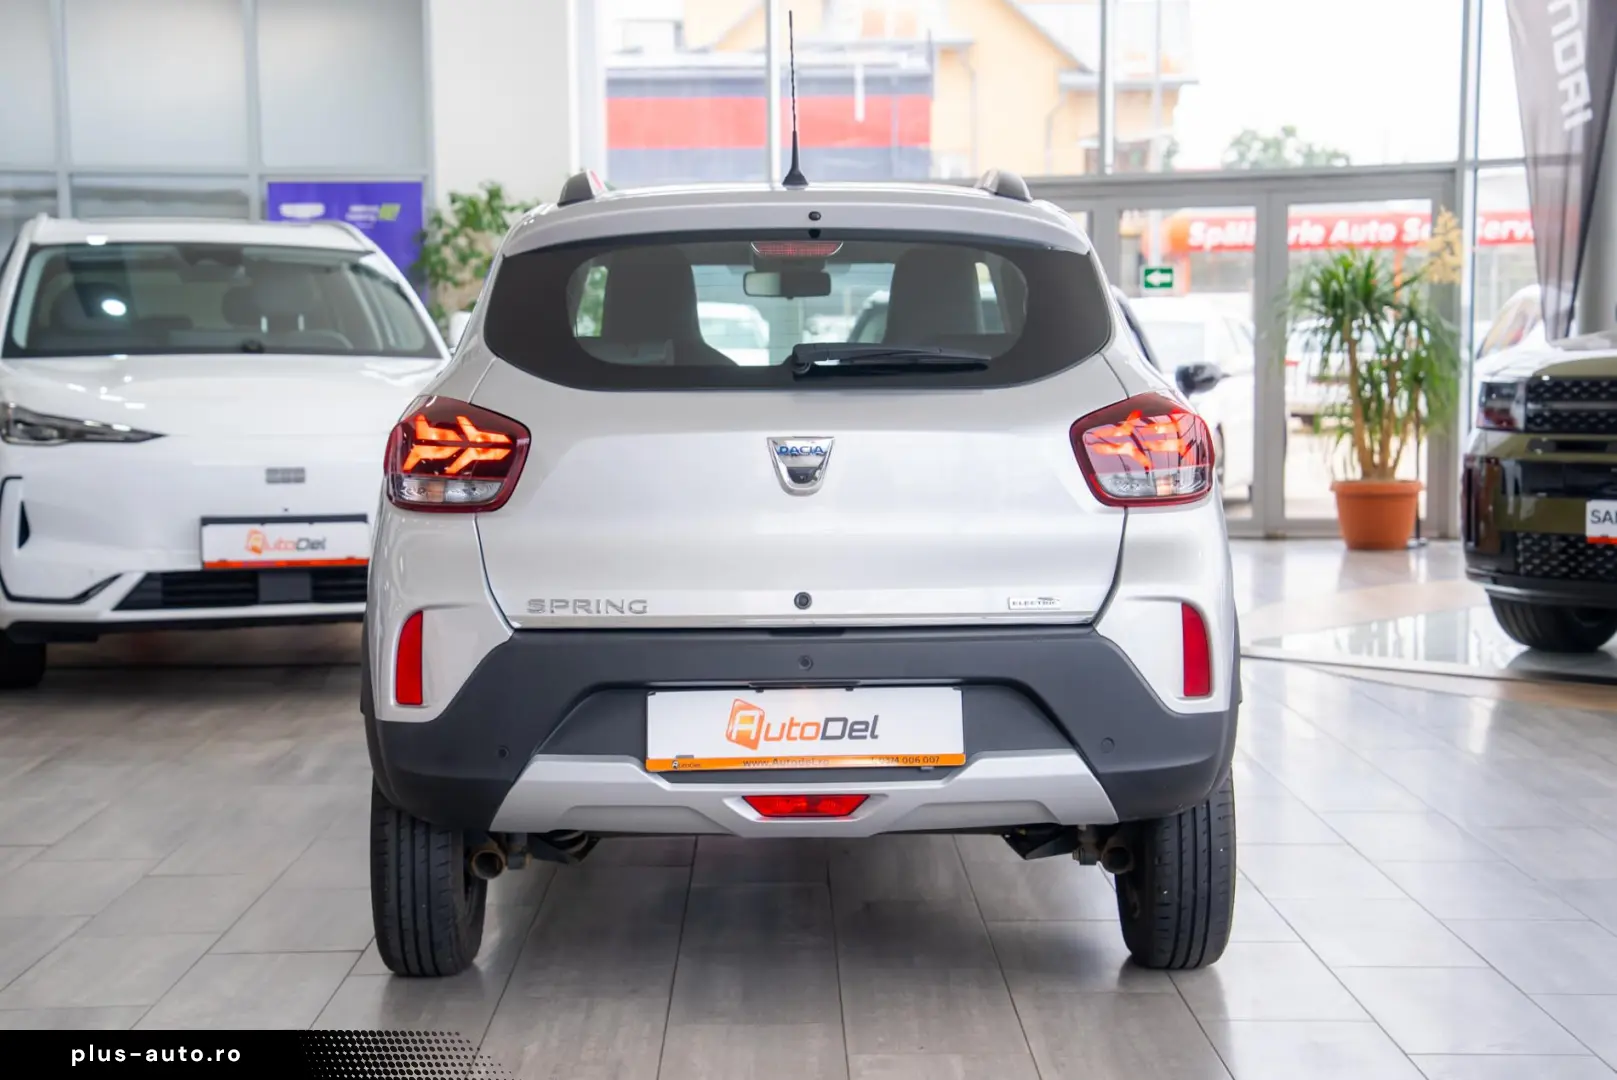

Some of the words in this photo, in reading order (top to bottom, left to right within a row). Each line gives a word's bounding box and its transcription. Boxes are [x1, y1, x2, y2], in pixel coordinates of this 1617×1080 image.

[1328, 219, 1396, 244] Auto
[779, 445, 824, 455] DACIA
[1590, 509, 1617, 525] SA
[527, 598, 648, 615] SPRING
[726, 699, 879, 750] AutoDel
